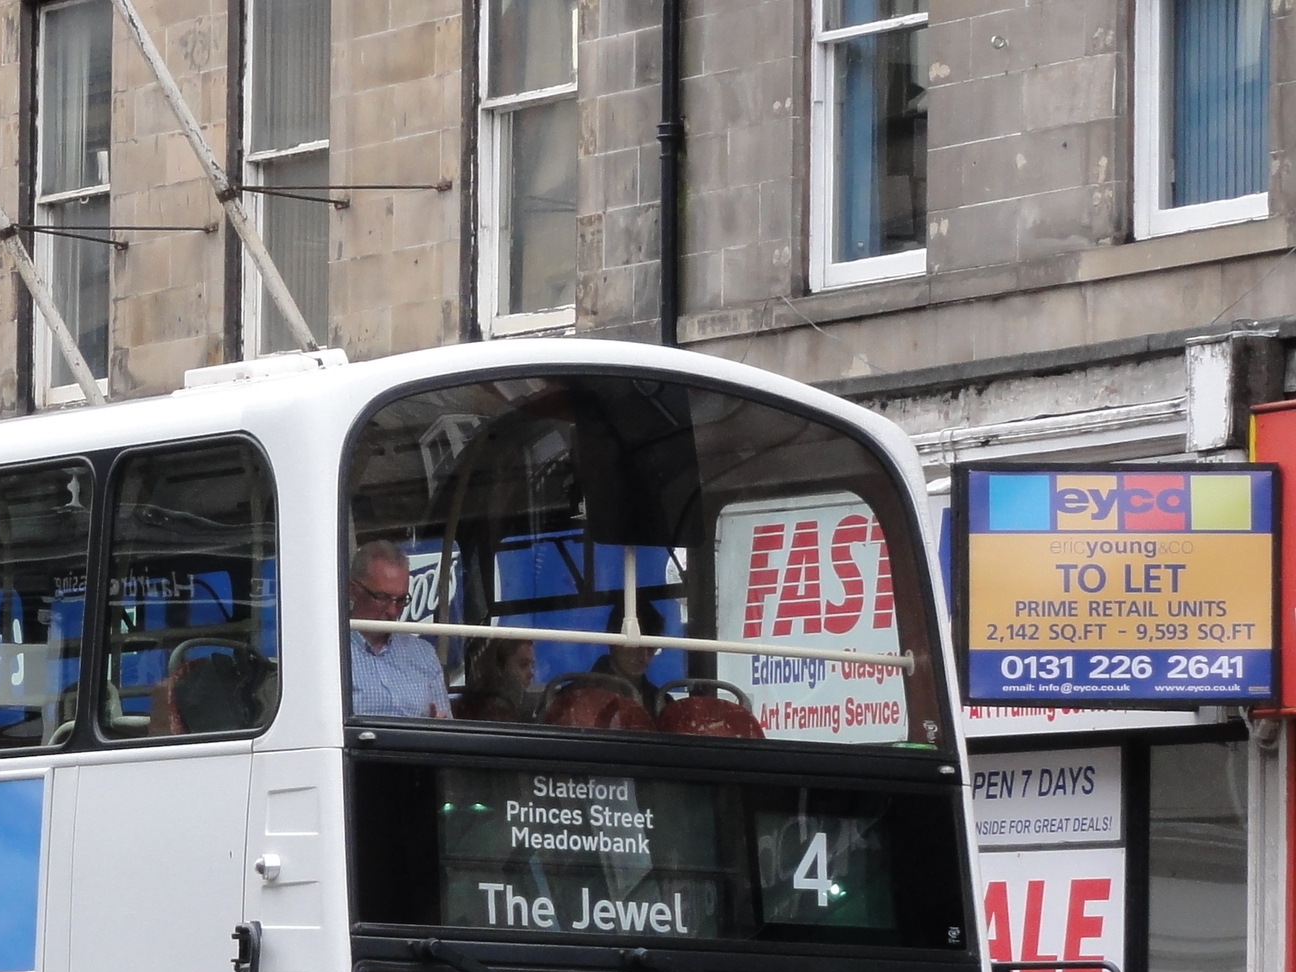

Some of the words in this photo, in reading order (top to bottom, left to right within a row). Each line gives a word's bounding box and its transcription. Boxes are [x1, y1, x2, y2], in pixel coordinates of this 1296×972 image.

[1056, 487, 1186, 521] eyco
[743, 514, 895, 639] FAST
[1056, 563, 1107, 593] TO
[1124, 563, 1186, 593] LET
[1015, 600, 1078, 617] PRIME
[1088, 600, 1158, 617] RETAIL
[1168, 600, 1227, 617] UNITS
[986, 623, 1039, 643] 2,142
[1049, 623, 1106, 643] SQ.FT
[1136, 623, 1188, 643] 9,593
[1198, 623, 1255, 643] SQ.FT
[752, 651, 826, 689] Edinburgh
[1001, 655, 1074, 679] 0131
[1089, 655, 1152, 679] 226
[1167, 655, 1244, 679] 2641
[1002, 683, 1035, 692] email:
[1039, 682, 1130, 694] info@eyco.co.uk
[1154, 682, 1241, 694] www.eyco.co.uk
[760, 702, 780, 731] Art
[784, 700, 840, 734] Framing
[844, 697, 900, 726] Service
[533, 775, 629, 801] Slateford
[972, 769, 1015, 800] PEN
[1021, 769, 1032, 798] 7
[1038, 766, 1095, 797] DAYS
[506, 800, 583, 826] Princes
[590, 804, 653, 829] Street
[975, 818, 1006, 836] NSIDE
[1009, 819, 1031, 834] FOR
[1034, 818, 1071, 833] GREAT
[1073, 815, 1113, 832] DEALS!
[510, 826, 650, 854] Meadowbank
[792, 832, 833, 907] 4
[478, 883, 555, 929] The
[572, 887, 688, 933] Jewel
